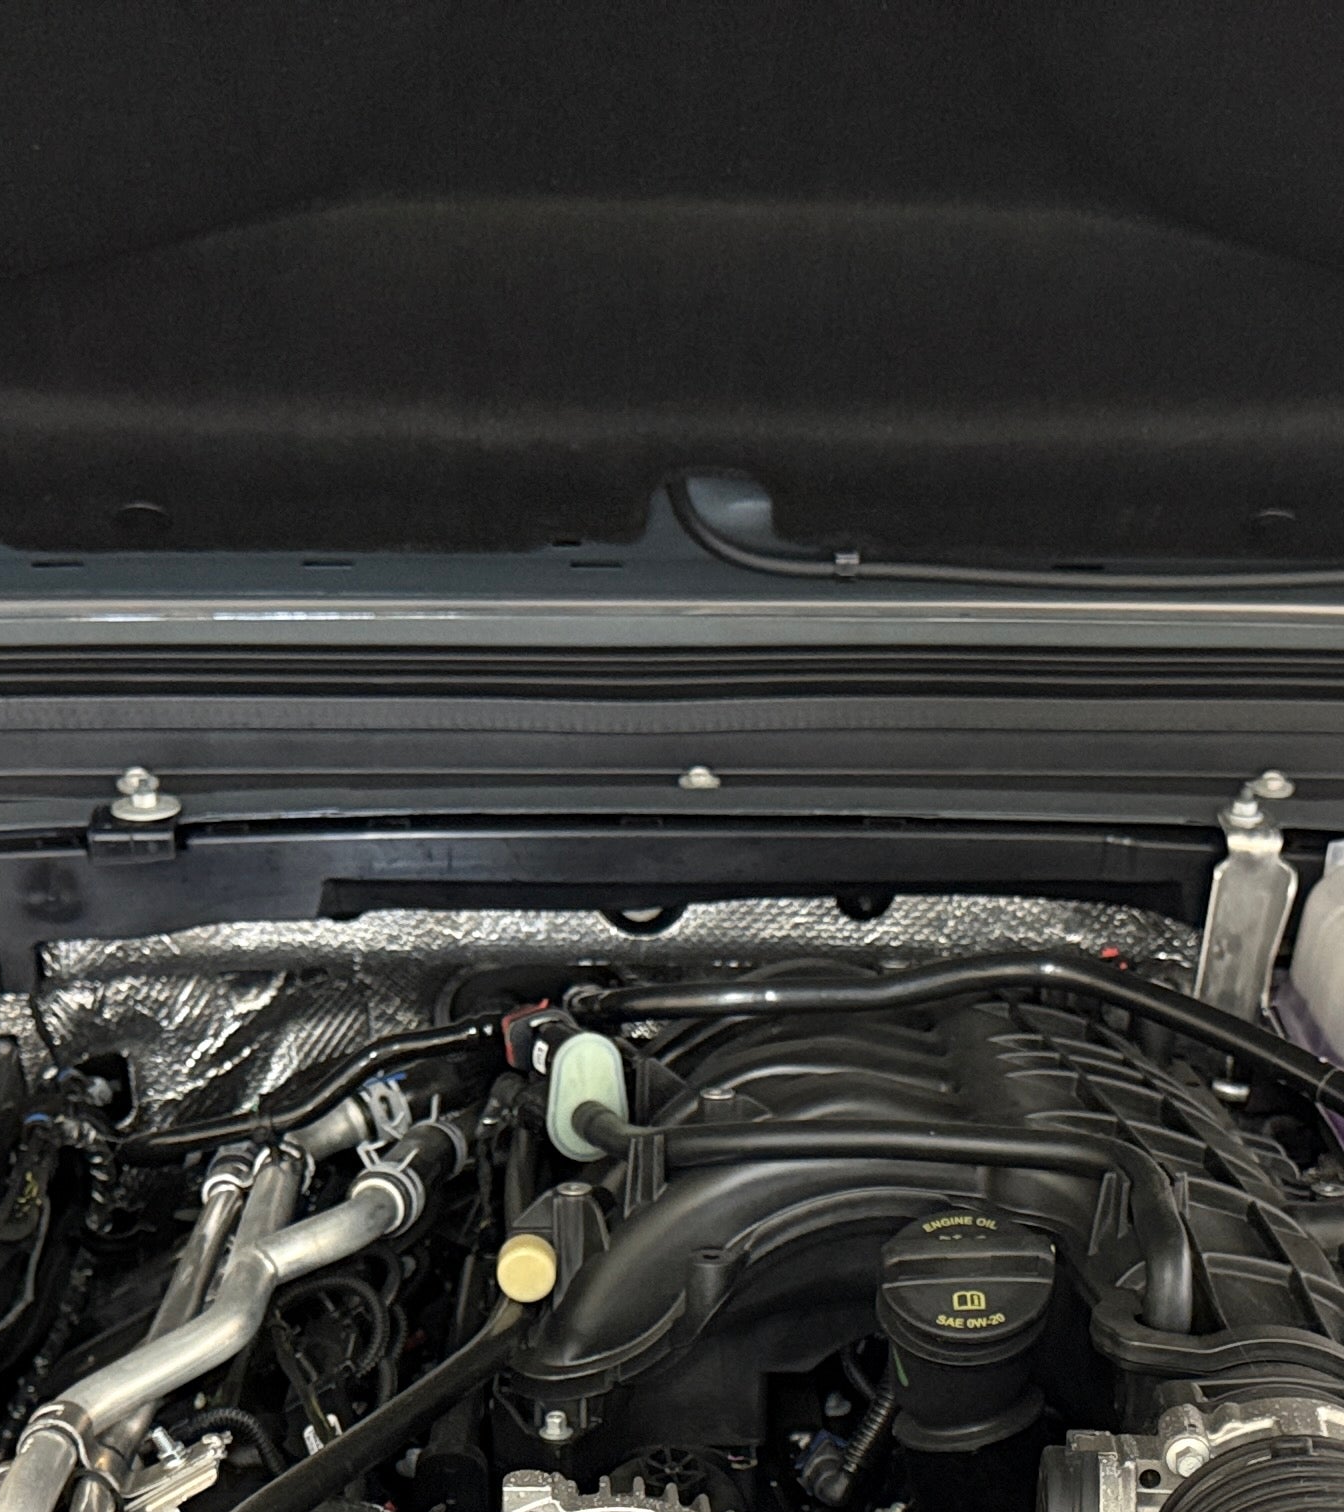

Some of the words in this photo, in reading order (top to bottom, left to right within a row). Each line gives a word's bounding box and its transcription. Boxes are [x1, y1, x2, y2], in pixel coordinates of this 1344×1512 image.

[922, 1216, 974, 1233] ENGINE
[976, 1217, 998, 1230] OIL
[936, 1314, 965, 1329] SAE
[966, 1313, 1006, 1329] 0W-20
